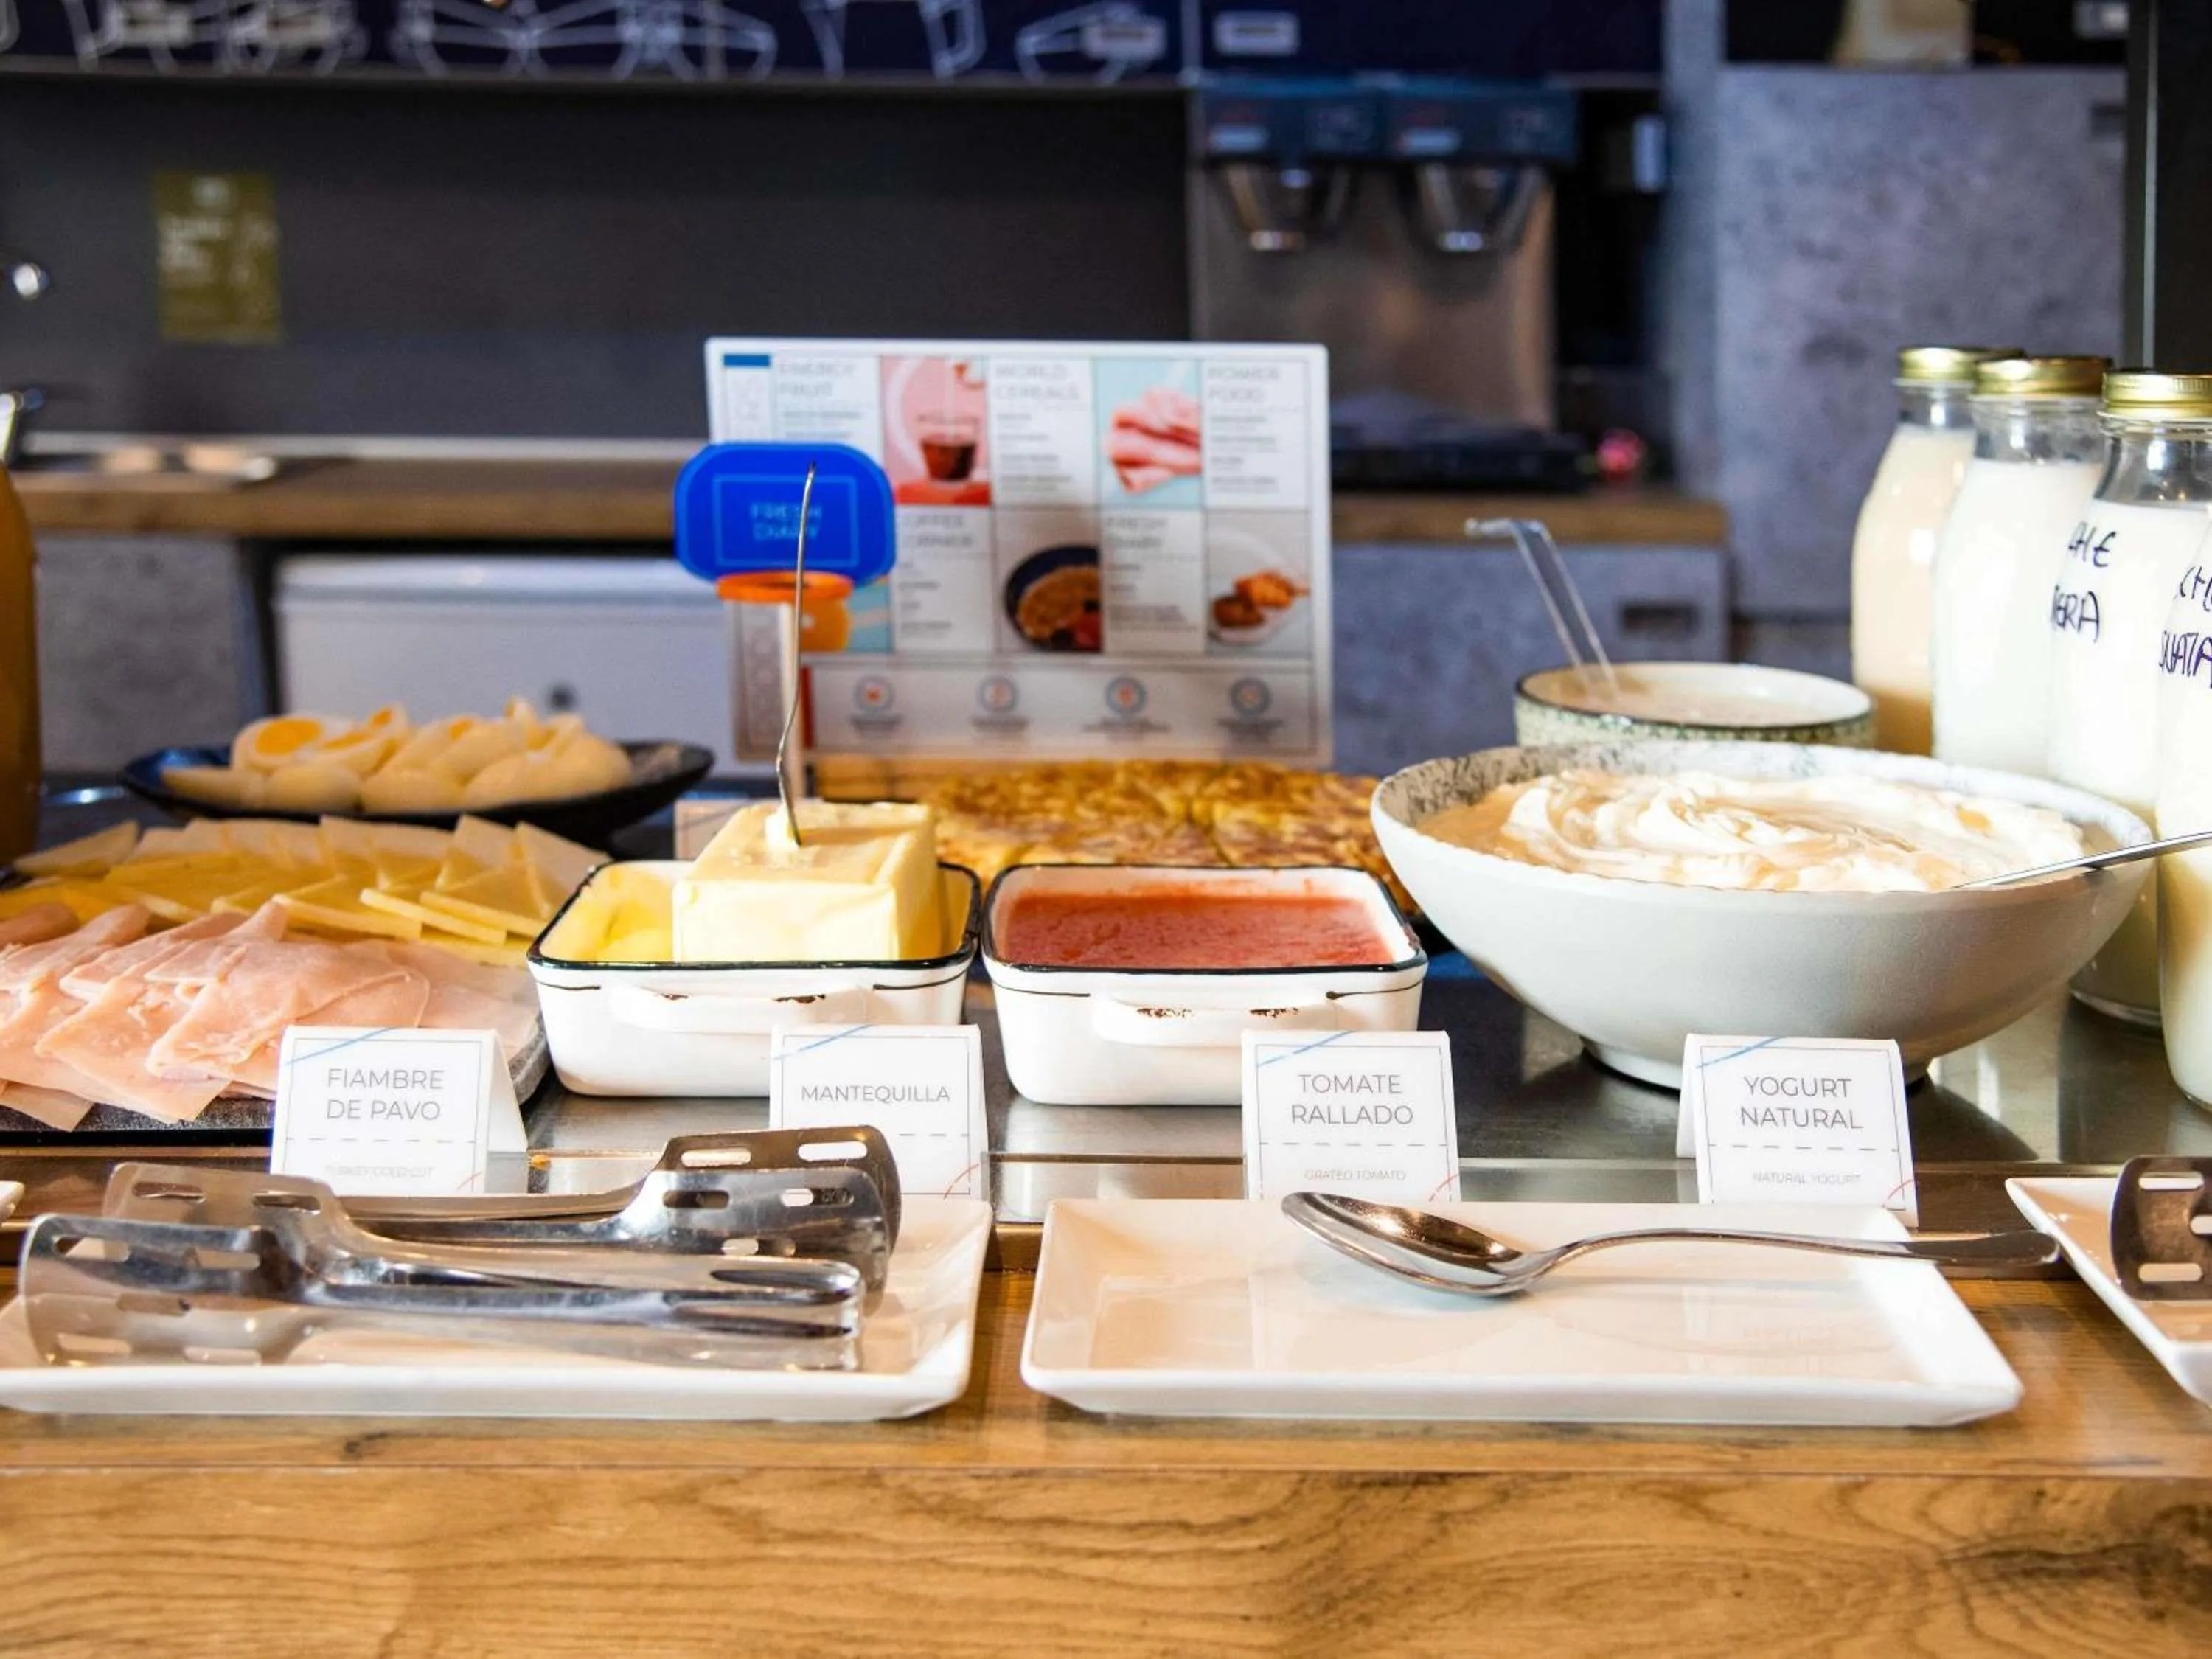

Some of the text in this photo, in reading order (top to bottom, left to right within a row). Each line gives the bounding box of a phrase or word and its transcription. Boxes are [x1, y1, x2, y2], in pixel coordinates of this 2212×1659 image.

[327, 1068, 445, 1090] FIAMBRE
[1298, 1074, 1404, 1094] TOMATE
[1743, 1076, 1852, 1098] YOGURT
[801, 1085, 950, 1104] MANTEQUILLA
[326, 1099, 442, 1121] DE PAVO
[1290, 1105, 1414, 1125] RALLADO
[1740, 1106, 1864, 1130] NATURAL
[1304, 1169, 1407, 1181] GRATED TOMATO
[1753, 1172, 1862, 1186] NATURAL YOGURT
